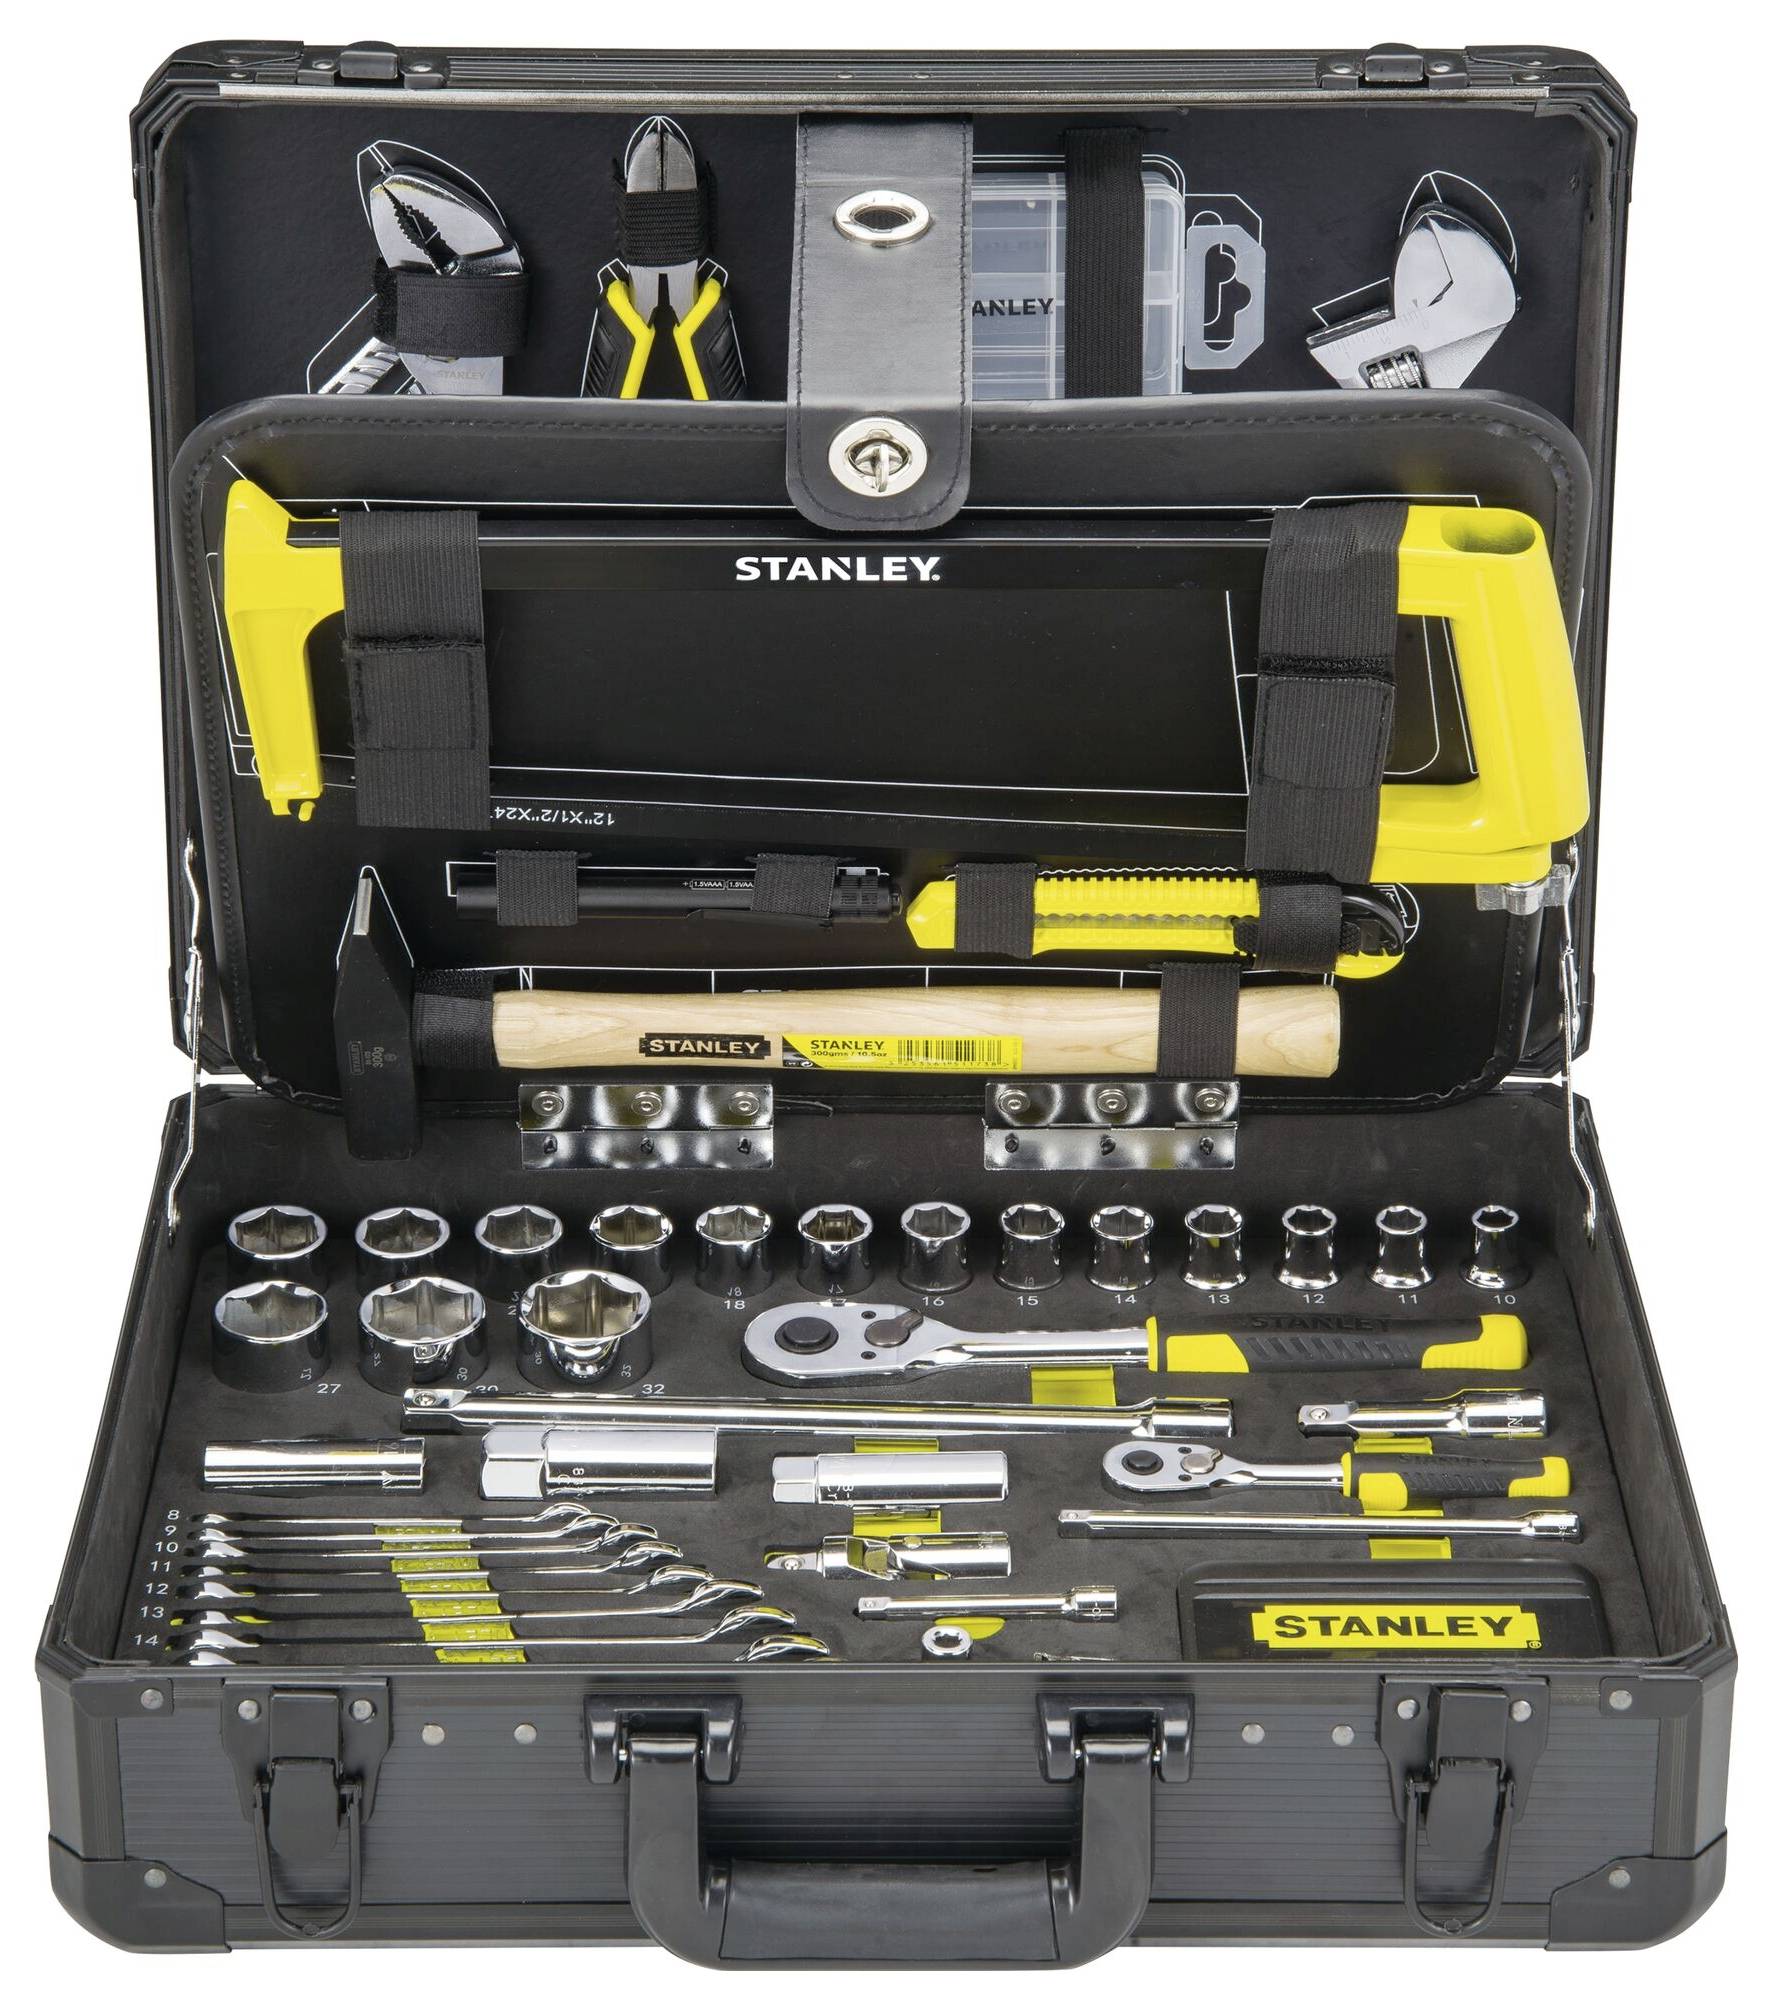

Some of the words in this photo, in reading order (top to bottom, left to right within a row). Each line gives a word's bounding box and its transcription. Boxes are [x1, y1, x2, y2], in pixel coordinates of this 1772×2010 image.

[972, 298, 1053, 317] ANLEY
[735, 556, 941, 581] STANLEY
[490, 806, 615, 826] 12"X1/2"X24
[649, 1039, 760, 1054] STANLEY
[810, 1040, 885, 1050] STANLEY
[724, 1300, 745, 1309] 18
[922, 1296, 945, 1307] 16
[1017, 1296, 1038, 1306] 15
[1114, 1294, 1137, 1304] 14
[1208, 1294, 1231, 1304] 13
[1303, 1294, 1326, 1304] 12
[1398, 1294, 1418, 1304] 11
[1494, 1294, 1516, 1305] 10
[1251, 1315, 1393, 1332] STANLEY
[317, 1383, 342, 1394] 27
[642, 1384, 665, 1395] 32
[167, 1510, 180, 1520] 8
[165, 1525, 177, 1536] 9
[154, 1541, 179, 1553] 10
[150, 1560, 171, 1572] 11
[146, 1583, 168, 1595] 12
[140, 1606, 164, 1618] 13
[1275, 1615, 1513, 1639] STANLEY
[134, 1634, 159, 1646] 14
